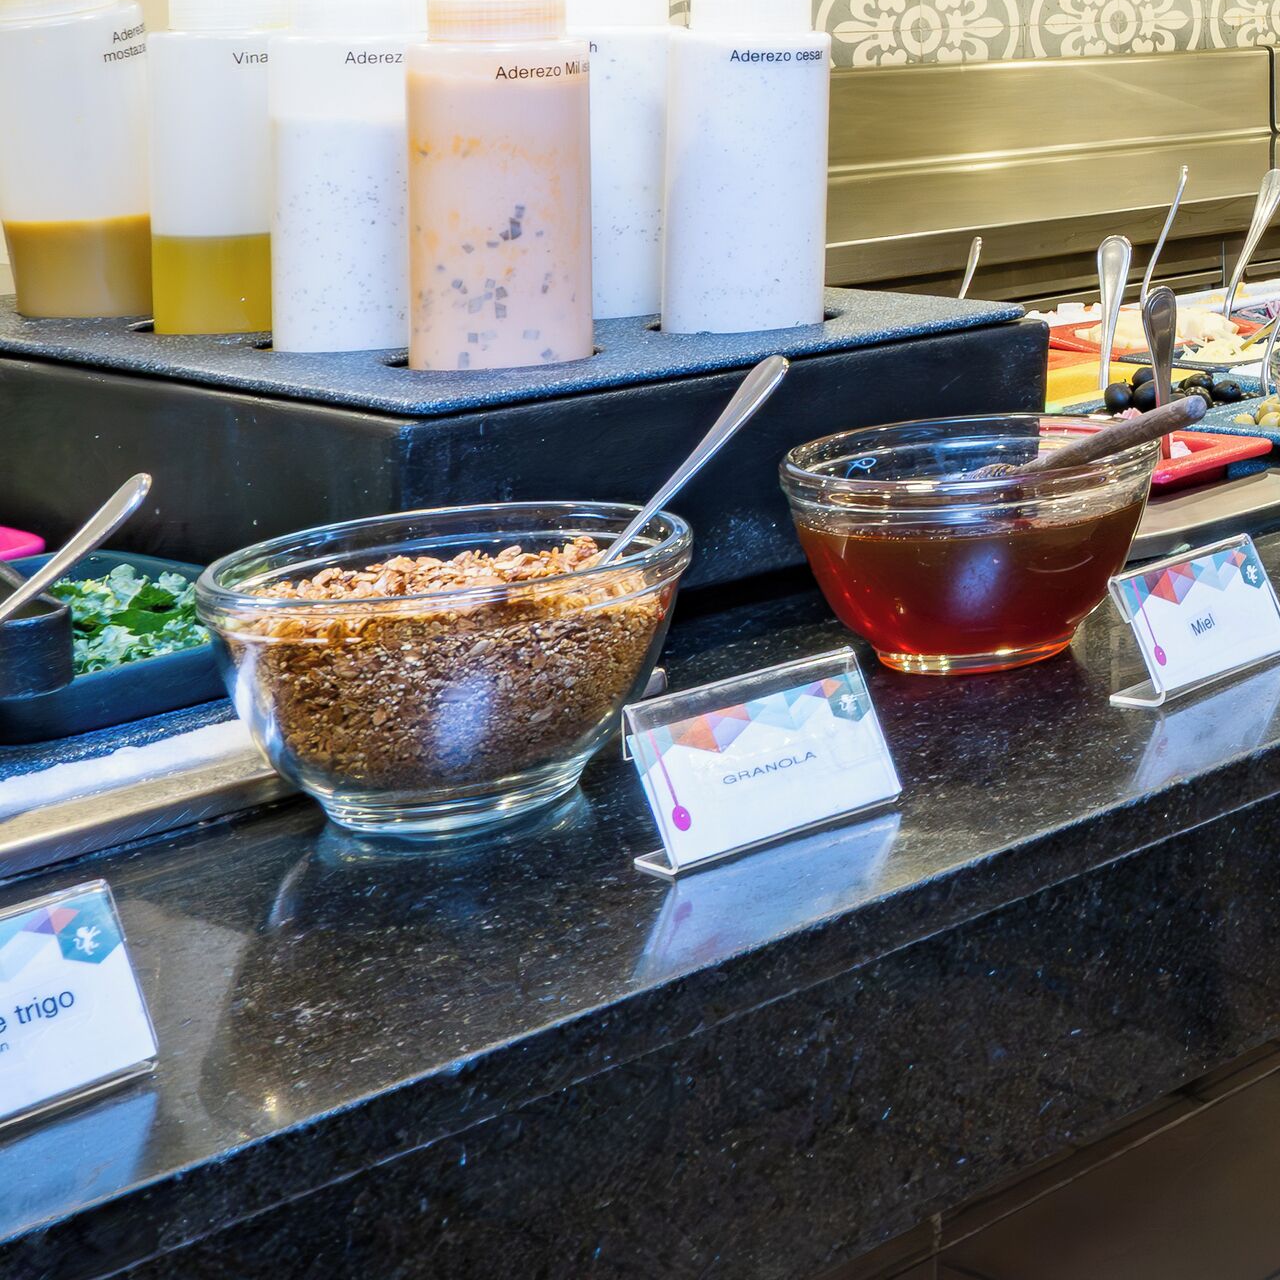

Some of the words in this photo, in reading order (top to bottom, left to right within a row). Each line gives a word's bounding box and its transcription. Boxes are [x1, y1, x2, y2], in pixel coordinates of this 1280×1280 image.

[233, 51, 268, 65] Vina
[345, 50, 403, 65] Aderez
[730, 49, 791, 63] Aderezo
[796, 50, 823, 62] cesar
[496, 66, 560, 79] Aderezo
[1191, 613, 1215, 636] Miel
[723, 751, 817, 785] GRANOLA
[14, 991, 74, 1024] trigo
